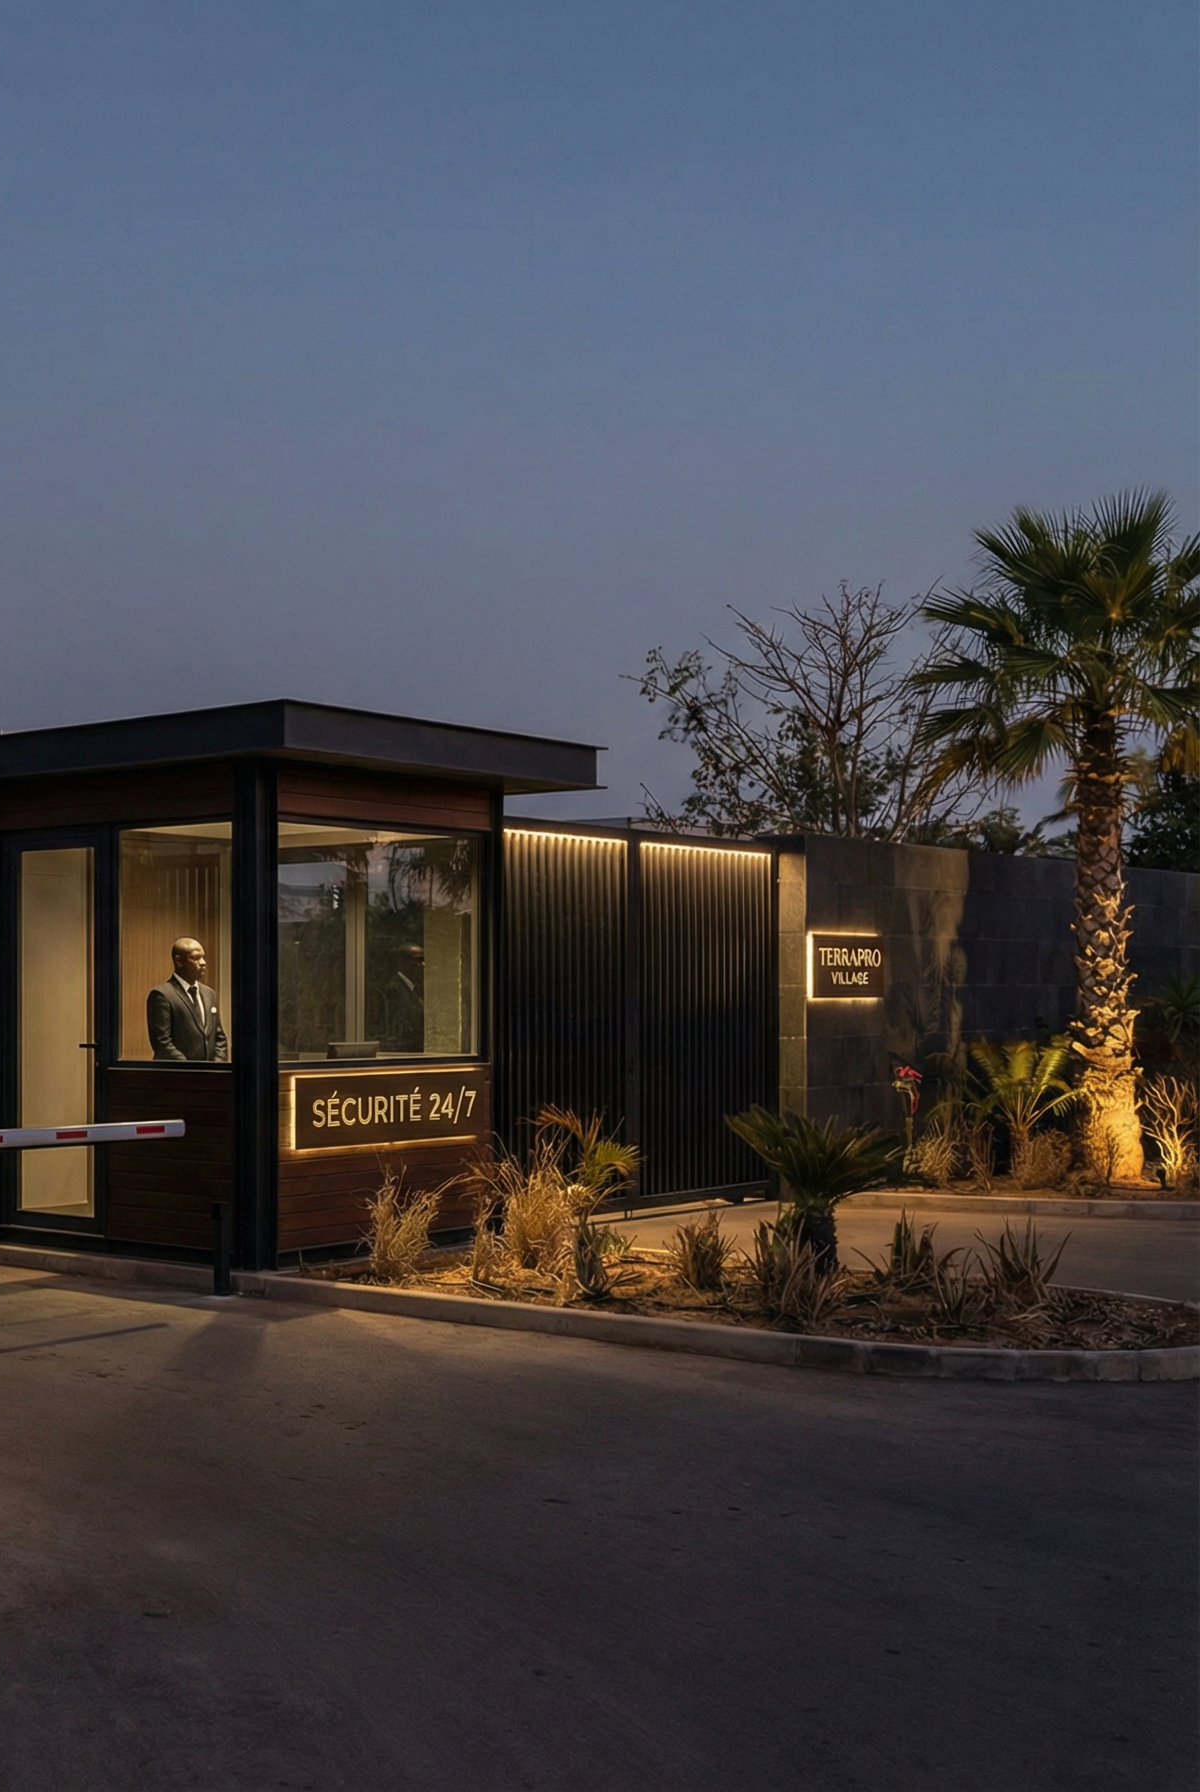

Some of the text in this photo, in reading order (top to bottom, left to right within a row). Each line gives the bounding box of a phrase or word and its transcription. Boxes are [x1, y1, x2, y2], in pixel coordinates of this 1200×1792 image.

[818, 947, 882, 968] TERRAPRO
[831, 971, 869, 986] VILLAGE
[312, 1085, 477, 1128] SÉCURITÉ 24/7
